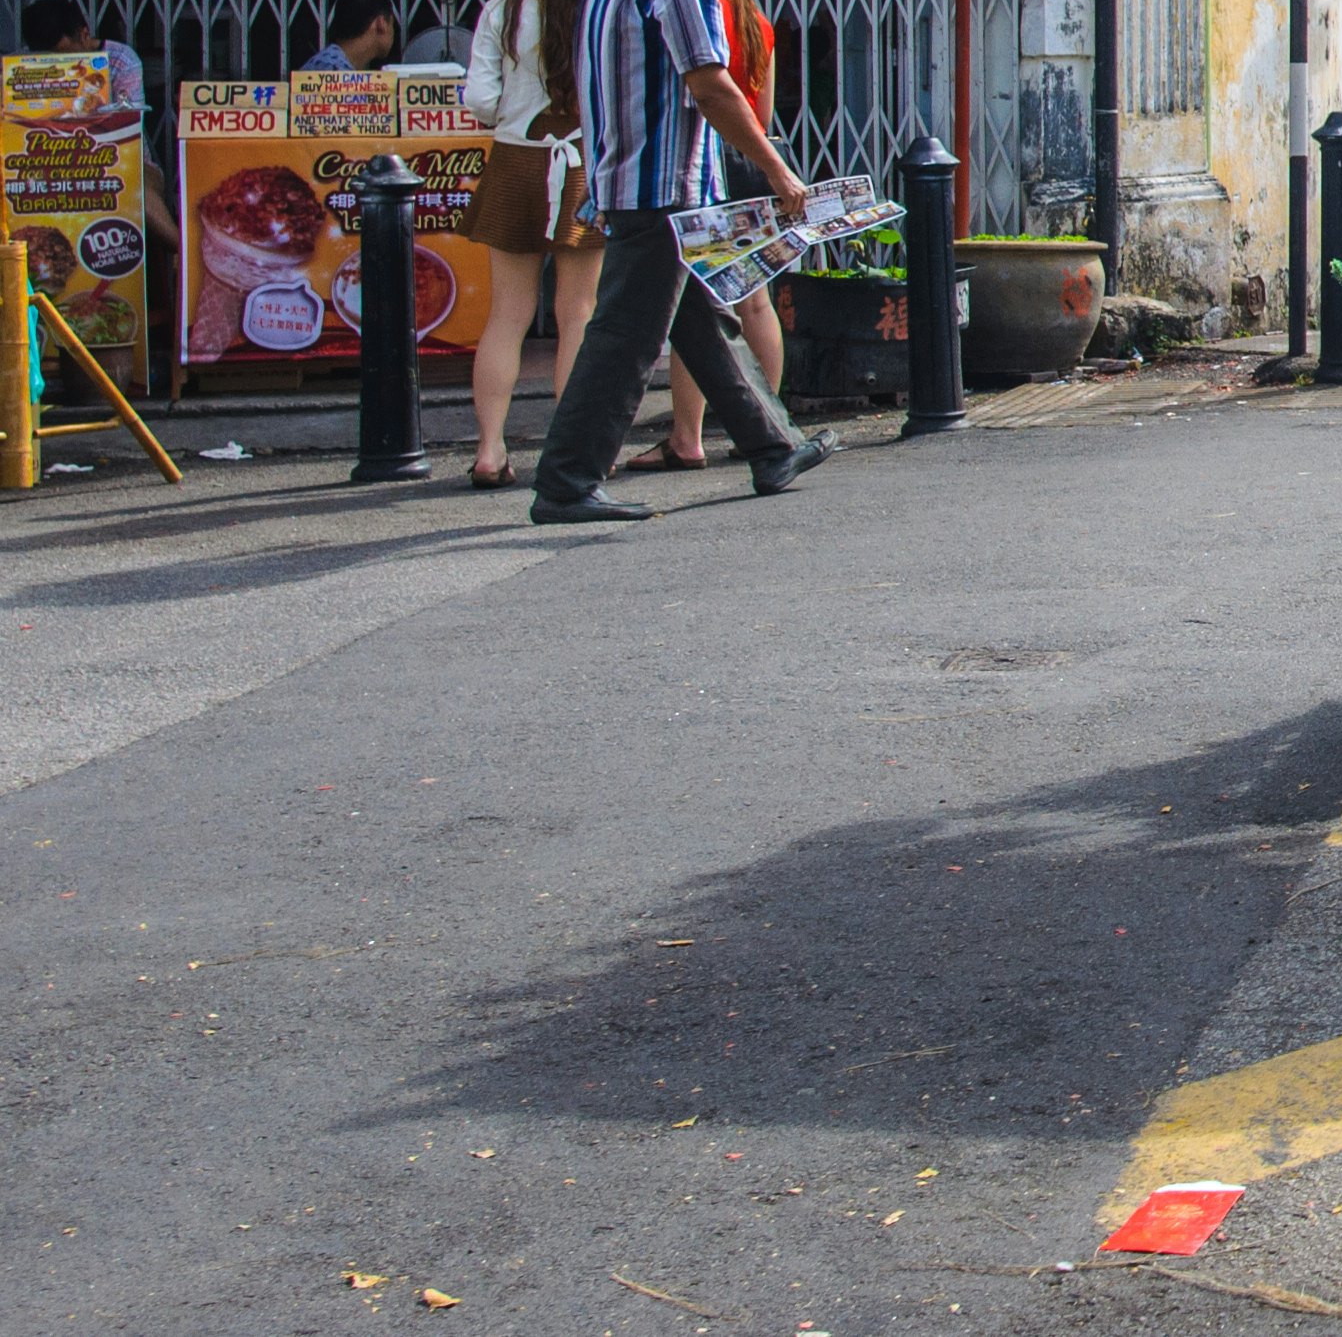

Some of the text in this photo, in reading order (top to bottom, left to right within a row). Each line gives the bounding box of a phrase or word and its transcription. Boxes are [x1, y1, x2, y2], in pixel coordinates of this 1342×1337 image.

[319, 74, 340, 84] YOU
[301, 82, 389, 92] BUY HAPPINESS
[193, 84, 248, 106] CUP
[295, 94, 391, 105] BUT YOU CAN BUY
[406, 84, 455, 106] CONE
[302, 103, 389, 115] ICE CREAM
[294, 115, 316, 125] AND
[352, 115, 379, 125] KIND
[380, 115, 395, 124] OF
[297, 125, 391, 135] THE SAME THING
[29, 130, 92, 155] Papa's
[8, 144, 114, 167] coconut milk
[318, 149, 484, 177] Coct Milk
[20, 165, 101, 180] ice cream
[84, 226, 138, 254] 100%
[97, 245, 130, 259] NATURAL
